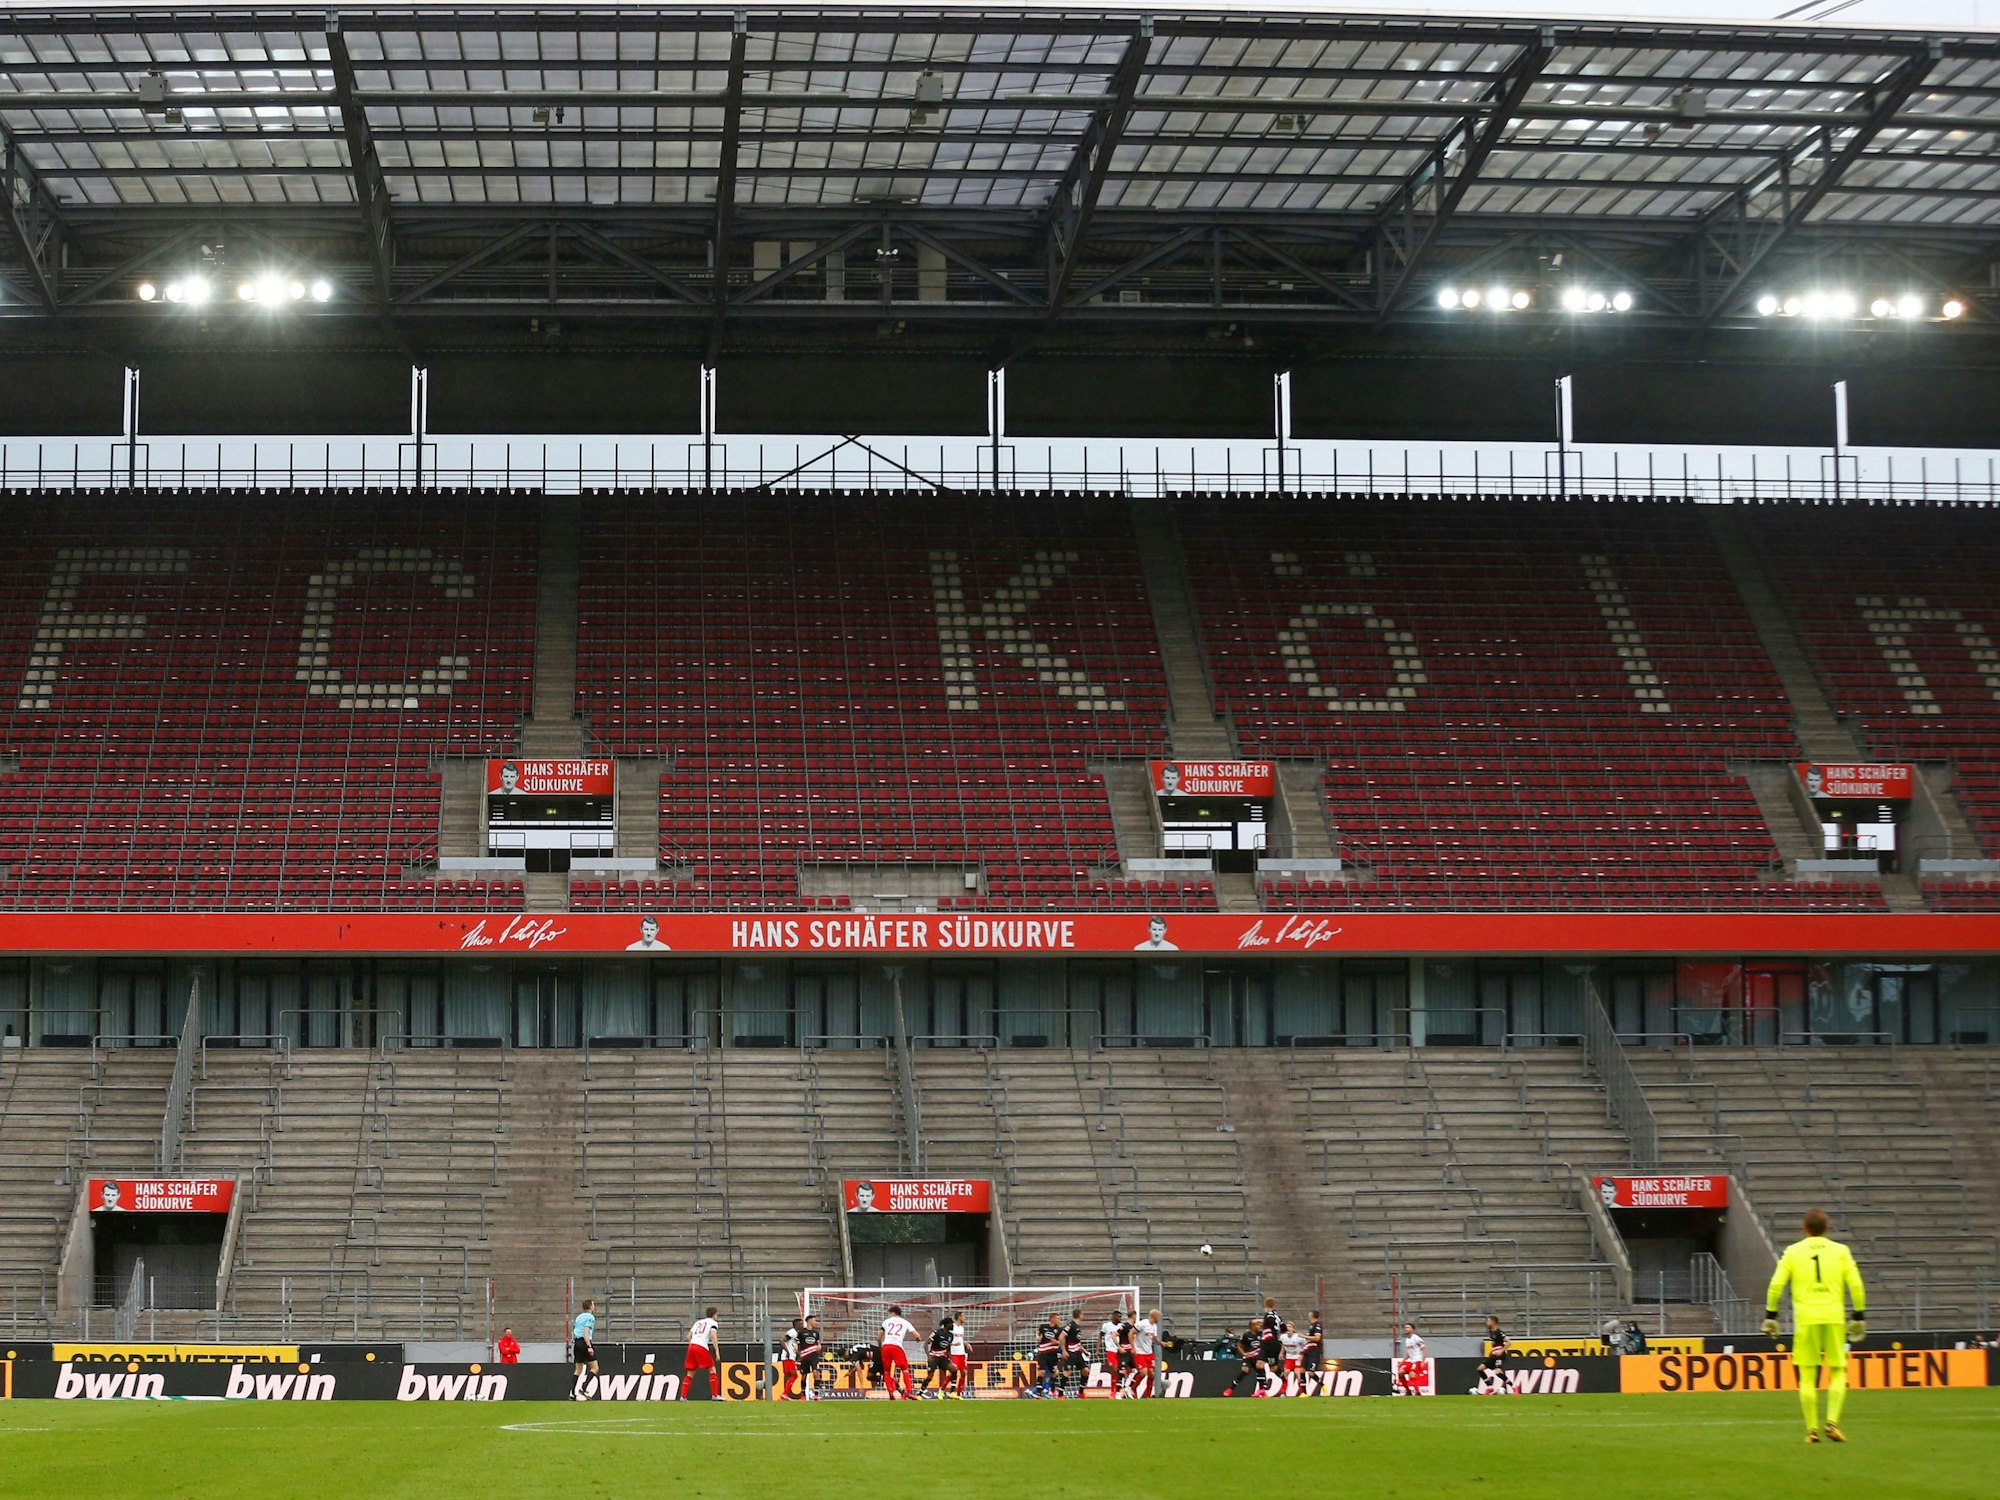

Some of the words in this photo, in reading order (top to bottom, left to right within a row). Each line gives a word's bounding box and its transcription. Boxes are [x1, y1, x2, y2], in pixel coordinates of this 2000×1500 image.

[523, 763, 554, 776] HANS
[557, 761, 609, 776] SCHÄFER
[1184, 765, 1214, 777] HANS
[1217, 763, 1269, 777] SCHÄFER
[1826, 768, 1855, 779] HANS
[1857, 766, 1908, 780] SCHÄFER
[523, 777, 583, 791] SÜDKURVE
[1184, 778, 1244, 792] SÜDKURVE
[1826, 780, 1884, 794] SÜDKURVE
[732, 920, 801, 948] HANS
[809, 915, 928, 948] SCHÄFER
[938, 915, 1075, 948] SÜDKURVE
[135, 1183, 164, 1195] HANS
[168, 1181, 218, 1195] SCHÄFER
[890, 1183, 919, 1196] HANS
[922, 1182, 972, 1196] SCHÄFER
[1631, 1180, 1660, 1191] HANS
[1662, 1178, 1712, 1192] SCHÄFER
[135, 1196, 193, 1209] SÜDKURVE
[889, 1196, 948, 1209] SÜDKURVE
[1631, 1192, 1688, 1205] SÜDKURVE
[1810, 1254, 1822, 1283] 1
[694, 1322, 708, 1335] 20
[887, 1322, 903, 1336] 22
[1659, 1352, 1948, 1391] SPORTTTEN
[54, 1362, 165, 1399] bwin
[225, 1363, 336, 1400] bwin
[396, 1363, 508, 1401] bwin
